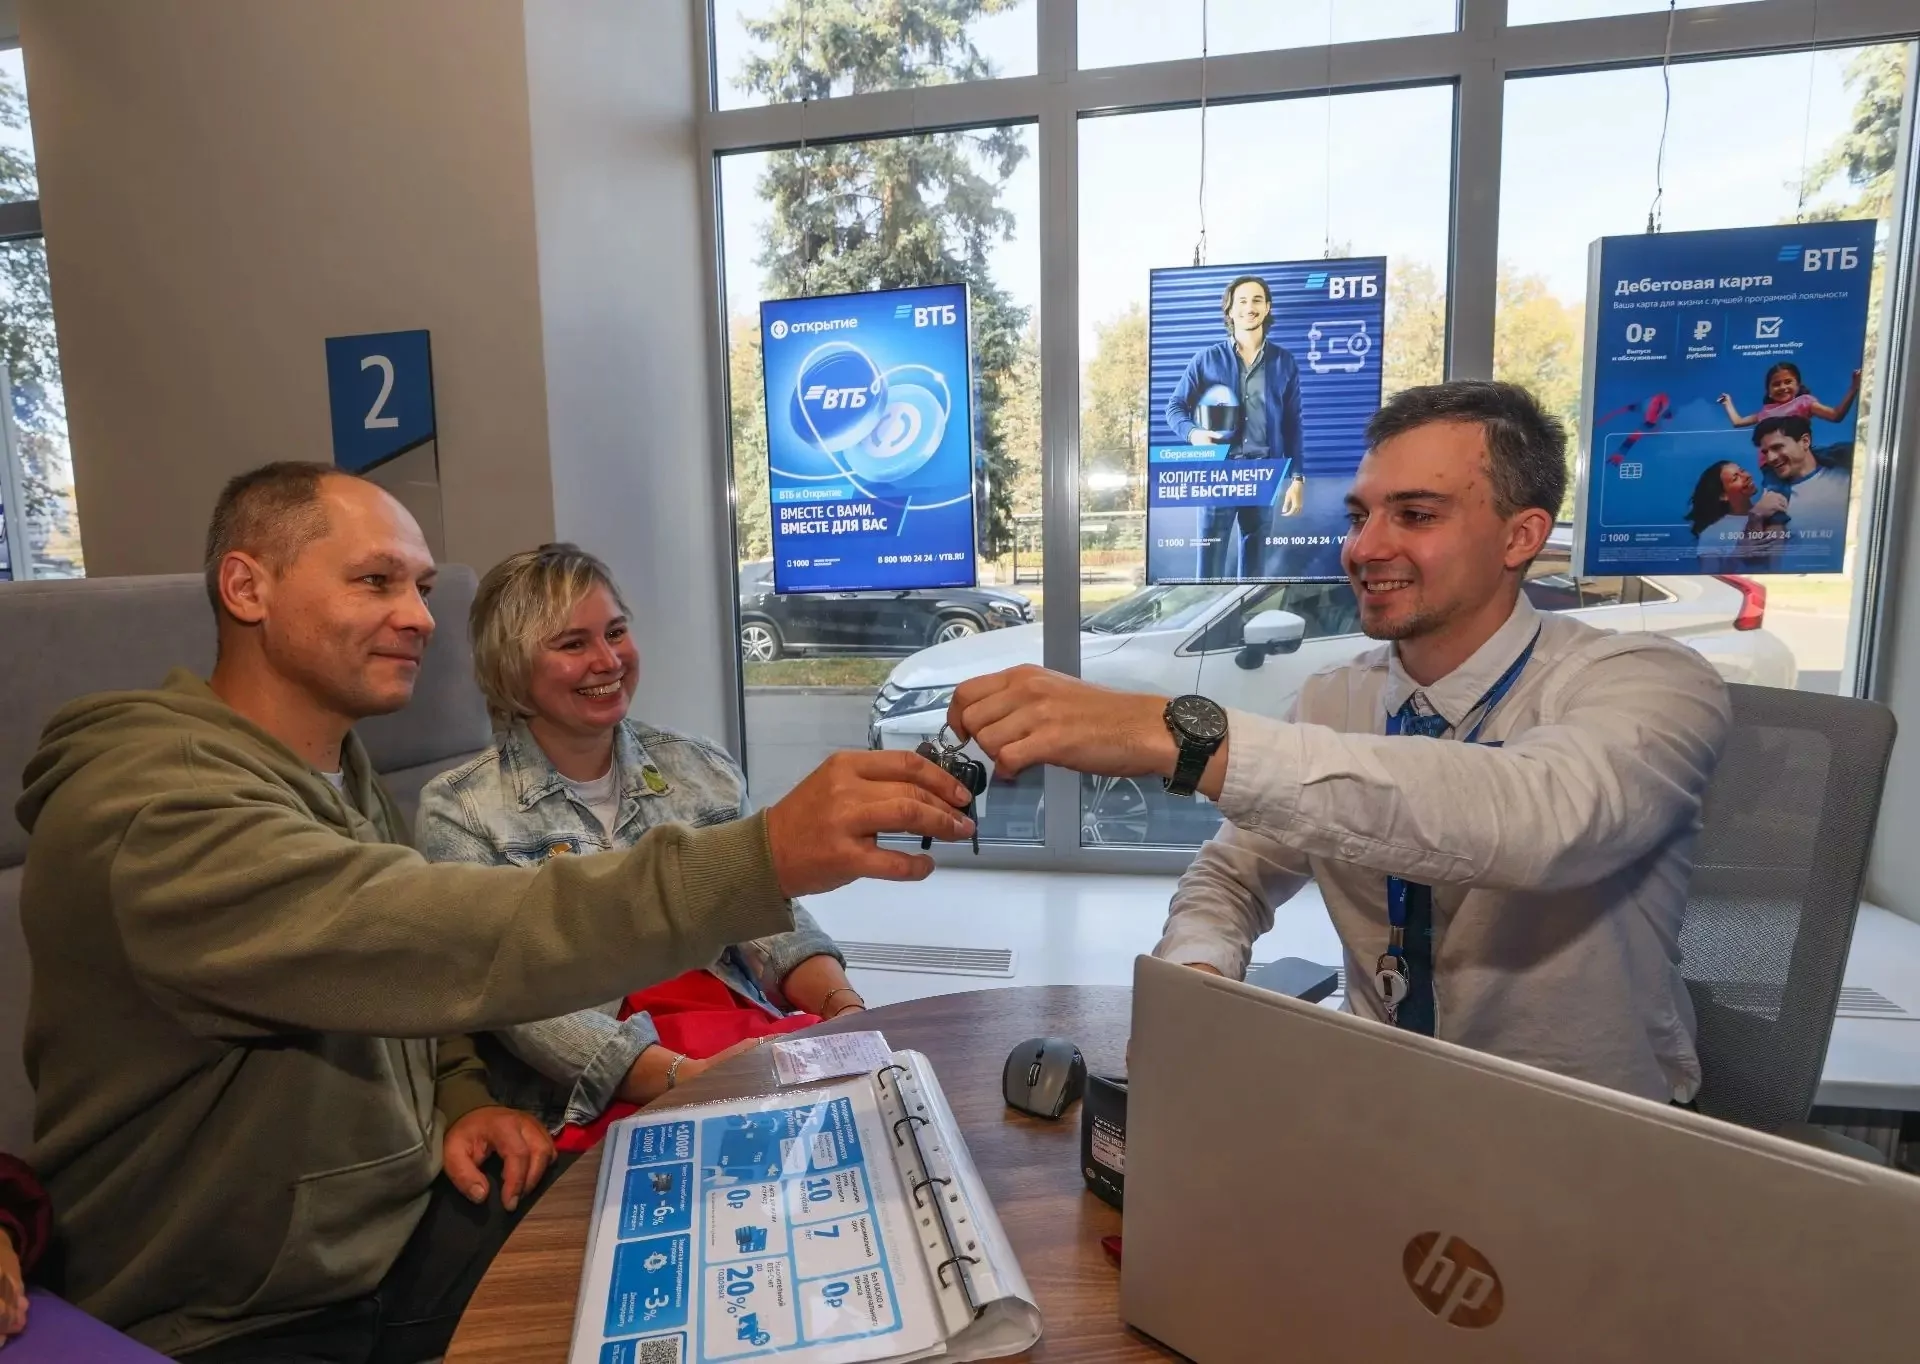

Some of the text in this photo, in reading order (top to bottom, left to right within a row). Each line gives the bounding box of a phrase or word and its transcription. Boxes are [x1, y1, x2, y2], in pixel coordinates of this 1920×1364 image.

[1803, 247, 1858, 272] ВТБ
[1328, 275, 1378, 299] ВТБ
[1615, 275, 1773, 296] Дебетовая карта
[1613, 301, 1635, 310] Ваша
[1636, 301, 1658, 310] карта
[1660, 300, 1675, 308] для
[1711, 296, 1743, 306] лучшей
[1744, 293, 1797, 304] программой
[1799, 291, 1848, 300] лояльности
[914, 305, 957, 328] ВТБ
[791, 317, 858, 335] открытие
[360, 354, 399, 429] 2
[823, 387, 868, 410] ВТБ
[1160, 449, 1216, 460] Сбережения
[1158, 468, 1274, 484] КОПИТЕ НА МЕЧТУ
[779, 489, 842, 500] ВТБ и Открытие
[1158, 483, 1257, 500] ЕЩЁ БЫСТРЕЕ!
[780, 503, 875, 520] ВМЕСТЕ С ВАМИ.
[781, 518, 888, 535] ВМЕСТЕ ДЛЯ ВАС
[1719, 532, 1726, 540] 8
[1727, 531, 1745, 540] 800
[1747, 531, 1763, 539] 100
[1766, 530, 1778, 539] 24
[1779, 530, 1791, 539] 24
[1165, 538, 1184, 547] 1000
[1265, 537, 1271, 545] 8
[1272, 537, 1289, 545] 800
[1291, 536, 1305, 545] 100
[1307, 536, 1318, 545] 24
[1319, 536, 1330, 545] 24
[1608, 533, 1630, 542] 1000
[792, 559, 810, 568] 1000
[877, 556, 883, 564] 8
[899, 555, 912, 563] 100
[913, 555, 924, 563] 24
[924, 554, 933, 562] 24
[938, 552, 965, 561] VTB.RU
[807, 1177, 833, 1202] 10
[813, 1224, 840, 1238] 7
[870, 1271, 879, 1282] Без
[1411, 1230, 1496, 1328] hp
[872, 1283, 884, 1303] КАСКО
